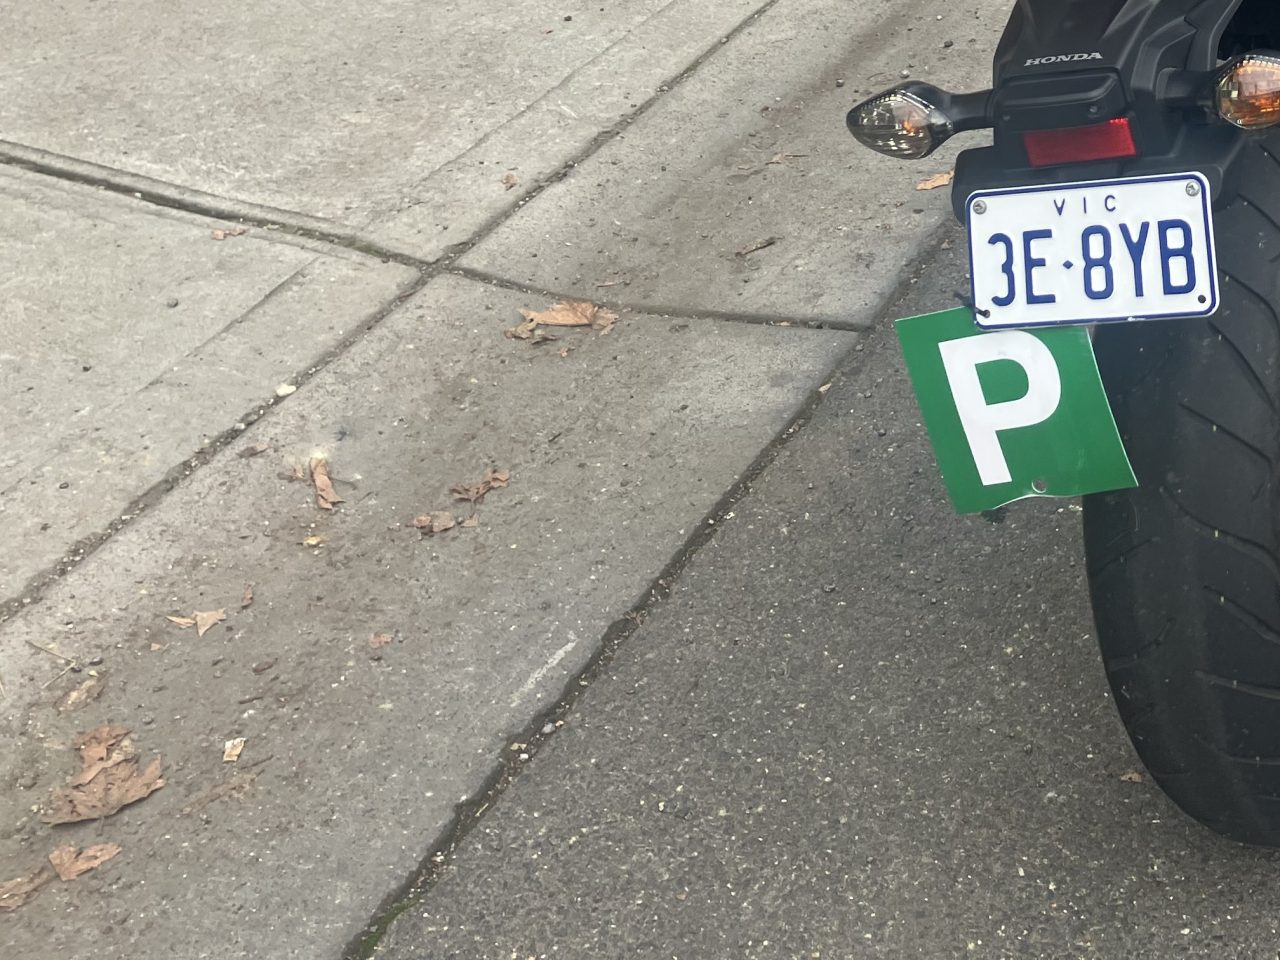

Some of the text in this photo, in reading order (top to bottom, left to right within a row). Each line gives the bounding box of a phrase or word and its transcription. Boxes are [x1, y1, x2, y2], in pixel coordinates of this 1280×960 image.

[1024, 52, 1104, 67] HONDA
[1053, 194, 1117, 216] VIC
[938, 329, 1062, 486] P
